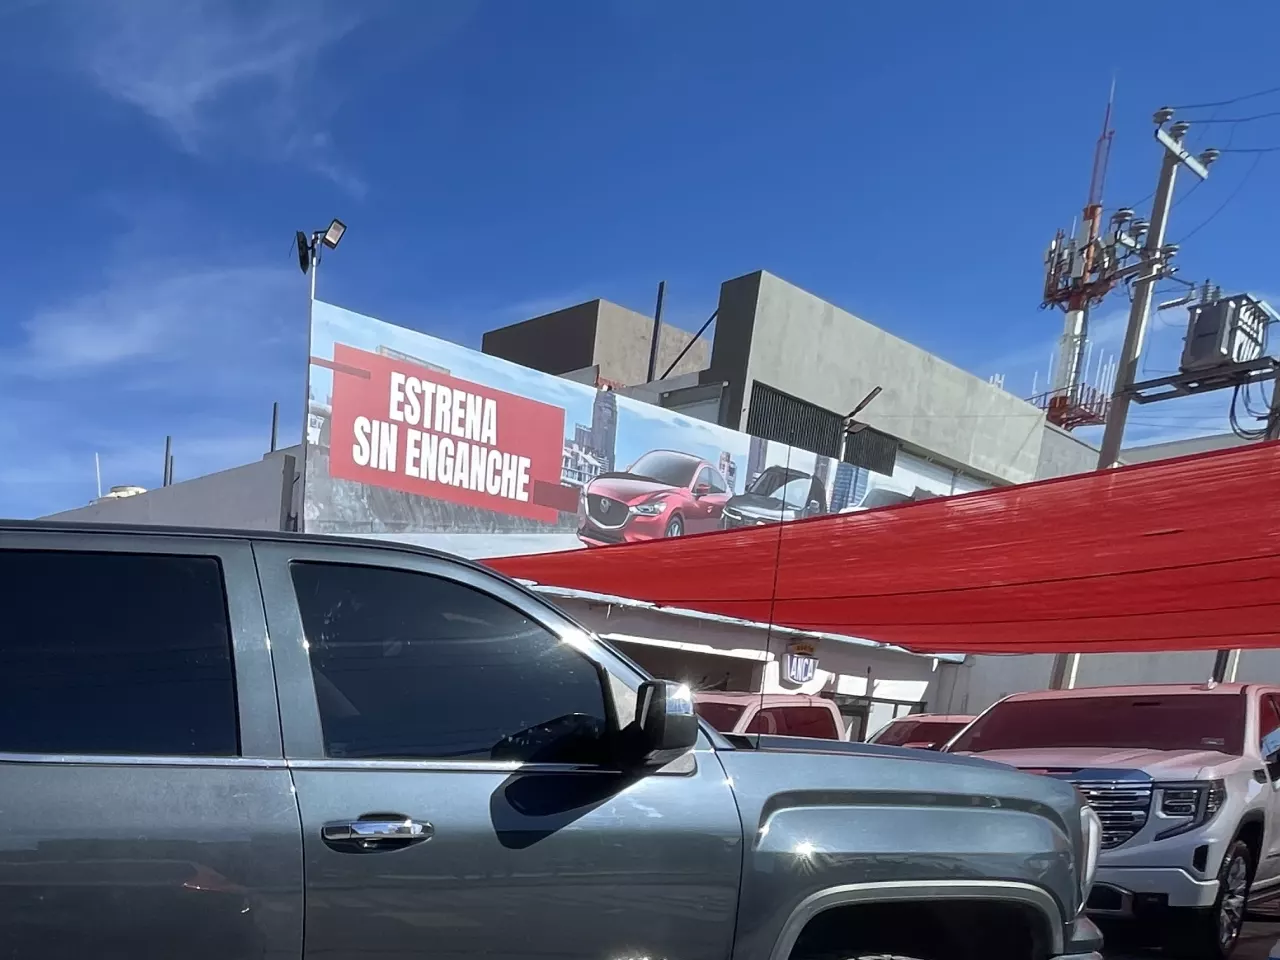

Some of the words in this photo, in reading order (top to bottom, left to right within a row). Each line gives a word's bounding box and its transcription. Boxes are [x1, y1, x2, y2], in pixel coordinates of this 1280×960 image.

[389, 371, 498, 445] ESTRENA
[353, 415, 398, 473] SIN
[405, 429, 532, 503] ENGANCHE
[790, 657, 814, 682] ANCA
